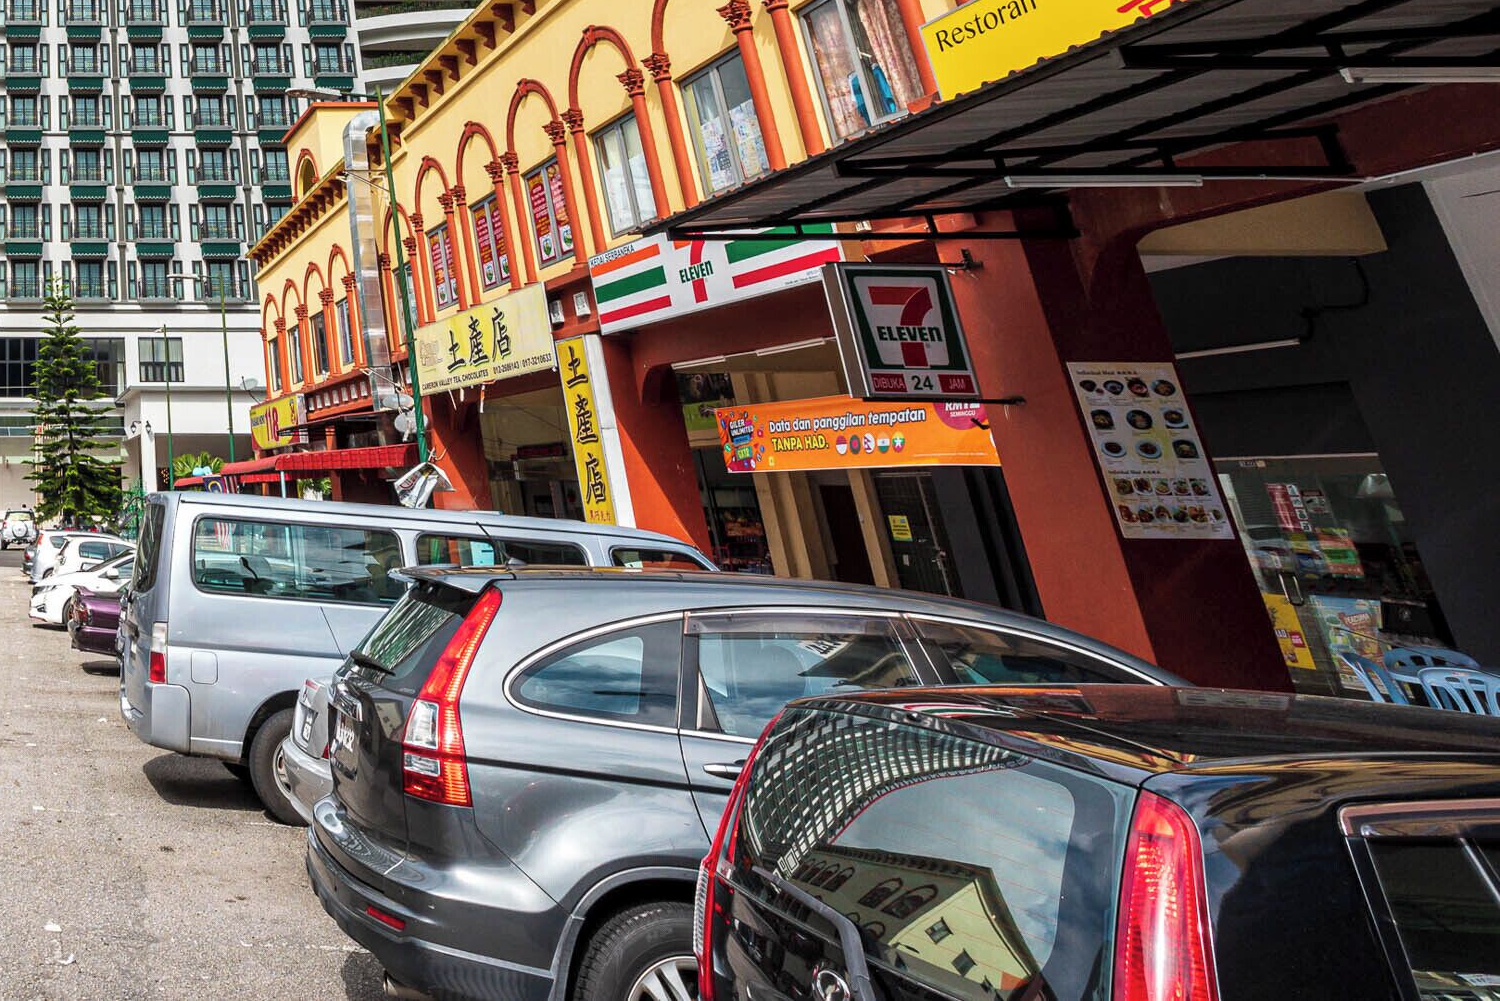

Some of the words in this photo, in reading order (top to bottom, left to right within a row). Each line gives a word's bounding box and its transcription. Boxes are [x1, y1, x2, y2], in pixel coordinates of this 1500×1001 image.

[447, 307, 512, 371] 土產店
[868, 286, 933, 366] 7
[874, 377, 905, 389] DIBUKA
[911, 375, 934, 391] 24
[948, 378, 966, 390] JAM
[265, 406, 280, 442] 118
[768, 421, 791, 433] Data
[792, 418, 811, 432] dan
[813, 413, 865, 431] panggilan
[868, 408, 926, 426] tempatan
[772, 436, 803, 452] TANPA
[804, 434, 829, 449] HAD.
